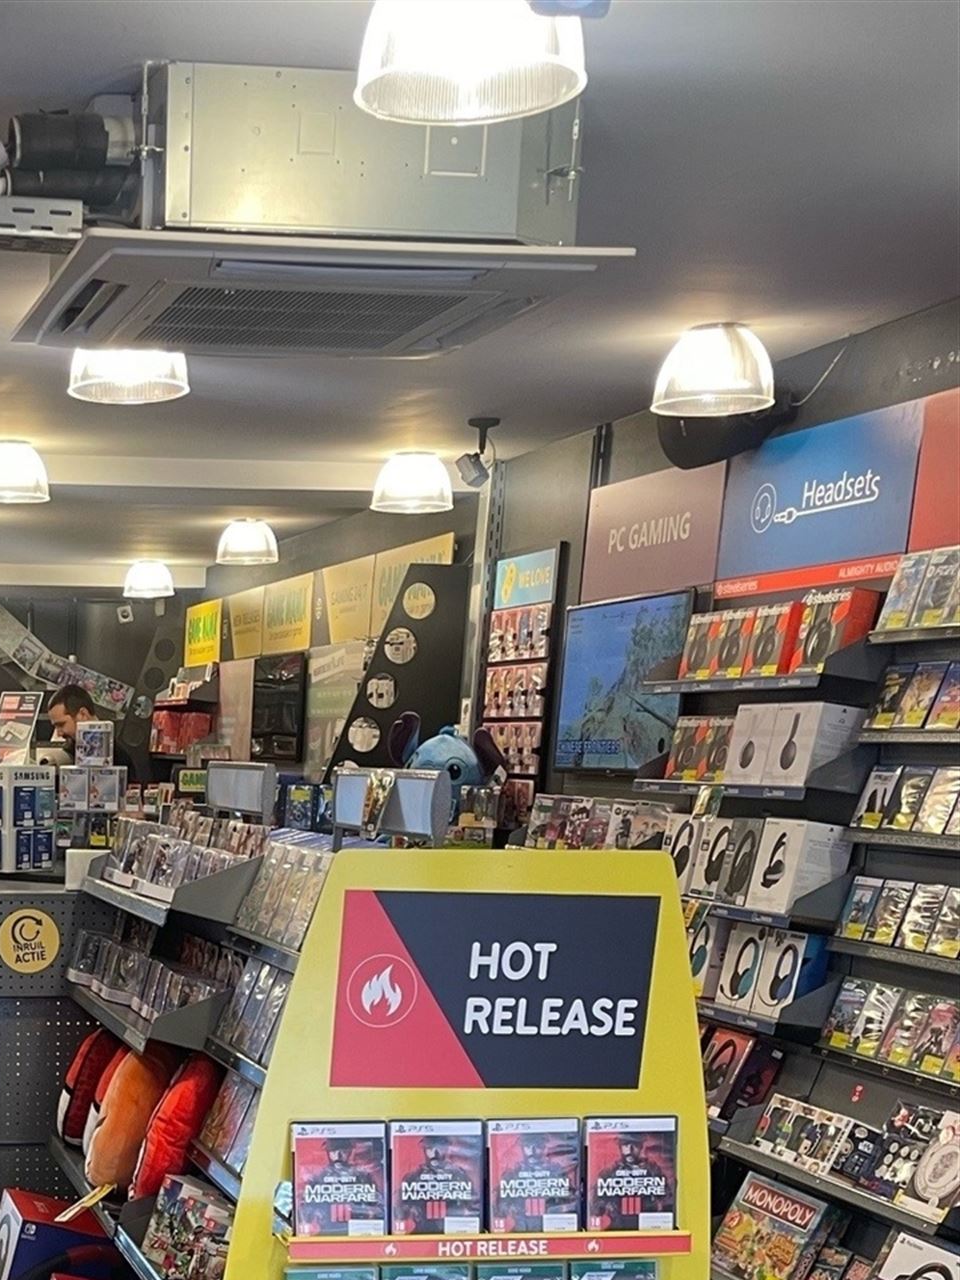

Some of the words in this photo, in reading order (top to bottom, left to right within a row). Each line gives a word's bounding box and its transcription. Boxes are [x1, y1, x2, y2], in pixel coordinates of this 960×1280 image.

[802, 469, 881, 509] Headsets
[607, 525, 626, 554] PC
[628, 511, 691, 549] GAMING
[839, 564, 873, 578] ALMIGHTY
[14, 771, 50, 780] SAMSUNG
[15, 951, 47, 964] ACTIE
[468, 941, 557, 980] HOT
[463, 997, 639, 1036] RELEASE
[401, 1182, 472, 1192] MODERN
[500, 1178, 570, 1188] MODERN
[597, 1177, 666, 1187] MODERN
[305, 1184, 376, 1193] MODERN
[500, 1187, 570, 1197] WARFARE
[597, 1186, 666, 1196] WARFARE
[305, 1193, 376, 1203] WARFARE
[401, 1191, 472, 1200] WARFARE
[744, 1186, 816, 1227] MONOPOLY
[438, 1241, 474, 1256] HOT
[476, 1240, 548, 1256] RELEASE
